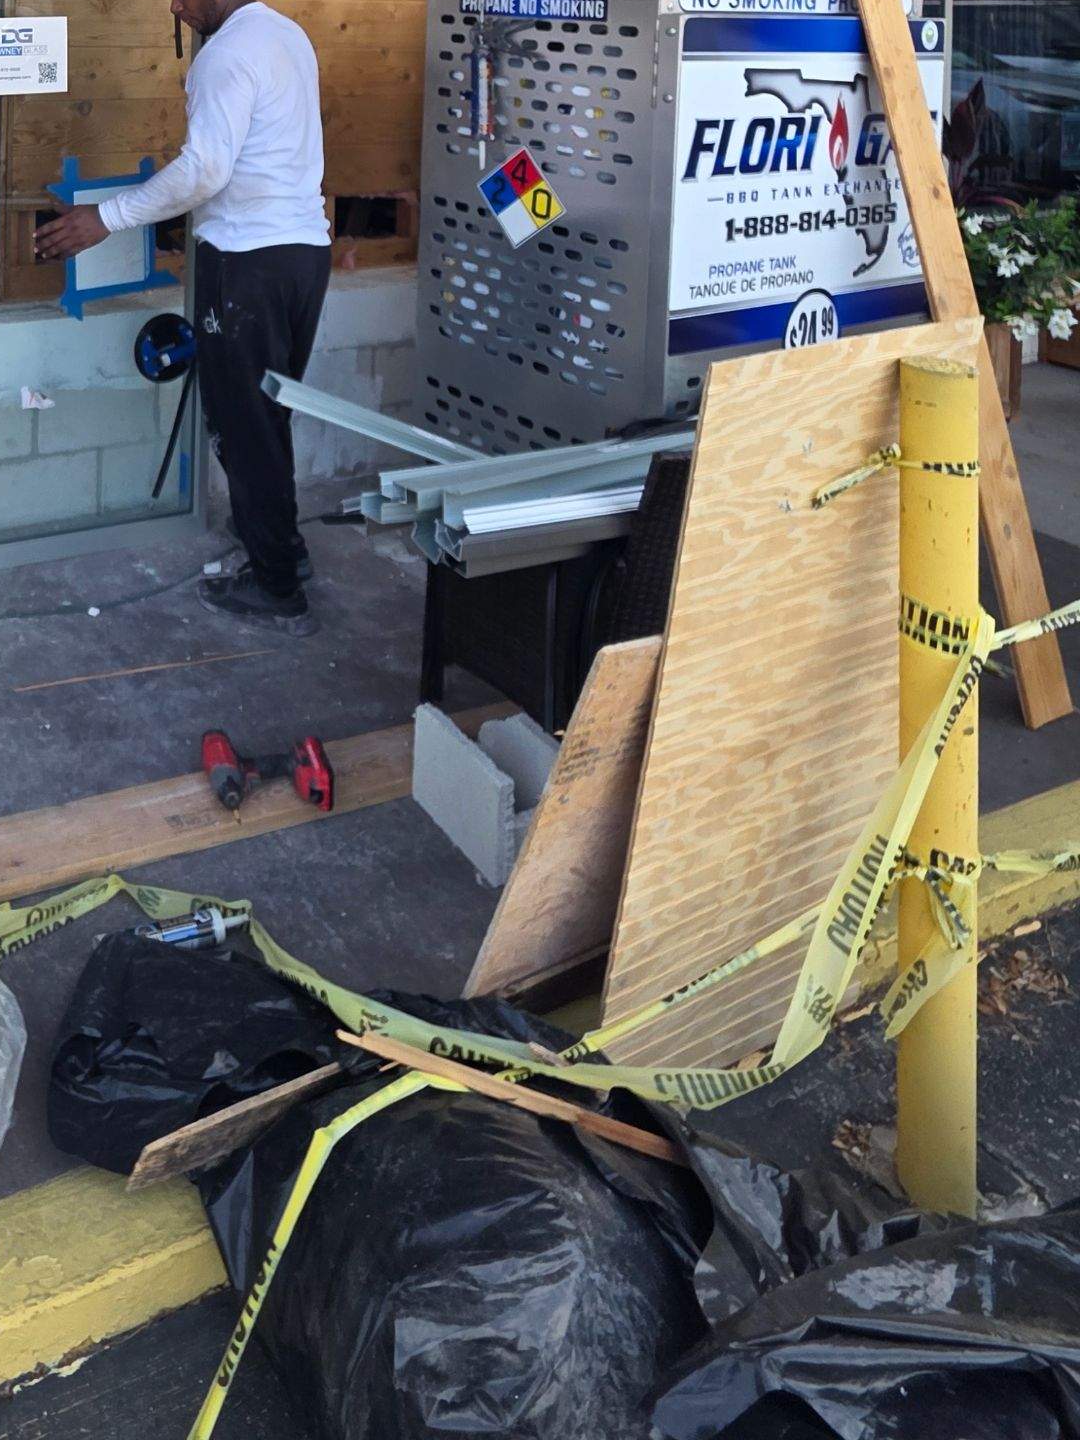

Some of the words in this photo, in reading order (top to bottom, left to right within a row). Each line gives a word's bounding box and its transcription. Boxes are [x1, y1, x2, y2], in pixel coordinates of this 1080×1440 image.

[511, 159, 528, 185] 4
[491, 177, 506, 205] 2
[531, 187, 552, 220] 0
[726, 190, 759, 204] BBQ
[771, 186, 813, 200] TANK
[824, 178, 901, 196] EXCHANGE
[725, 203, 898, 243] 1-888-814-0365
[708, 260, 765, 279] PROPANE
[769, 255, 797, 271] TANK
[689, 279, 737, 300] TANQUE
[740, 278, 757, 293] DE
[760, 270, 814, 289] PROPANO
